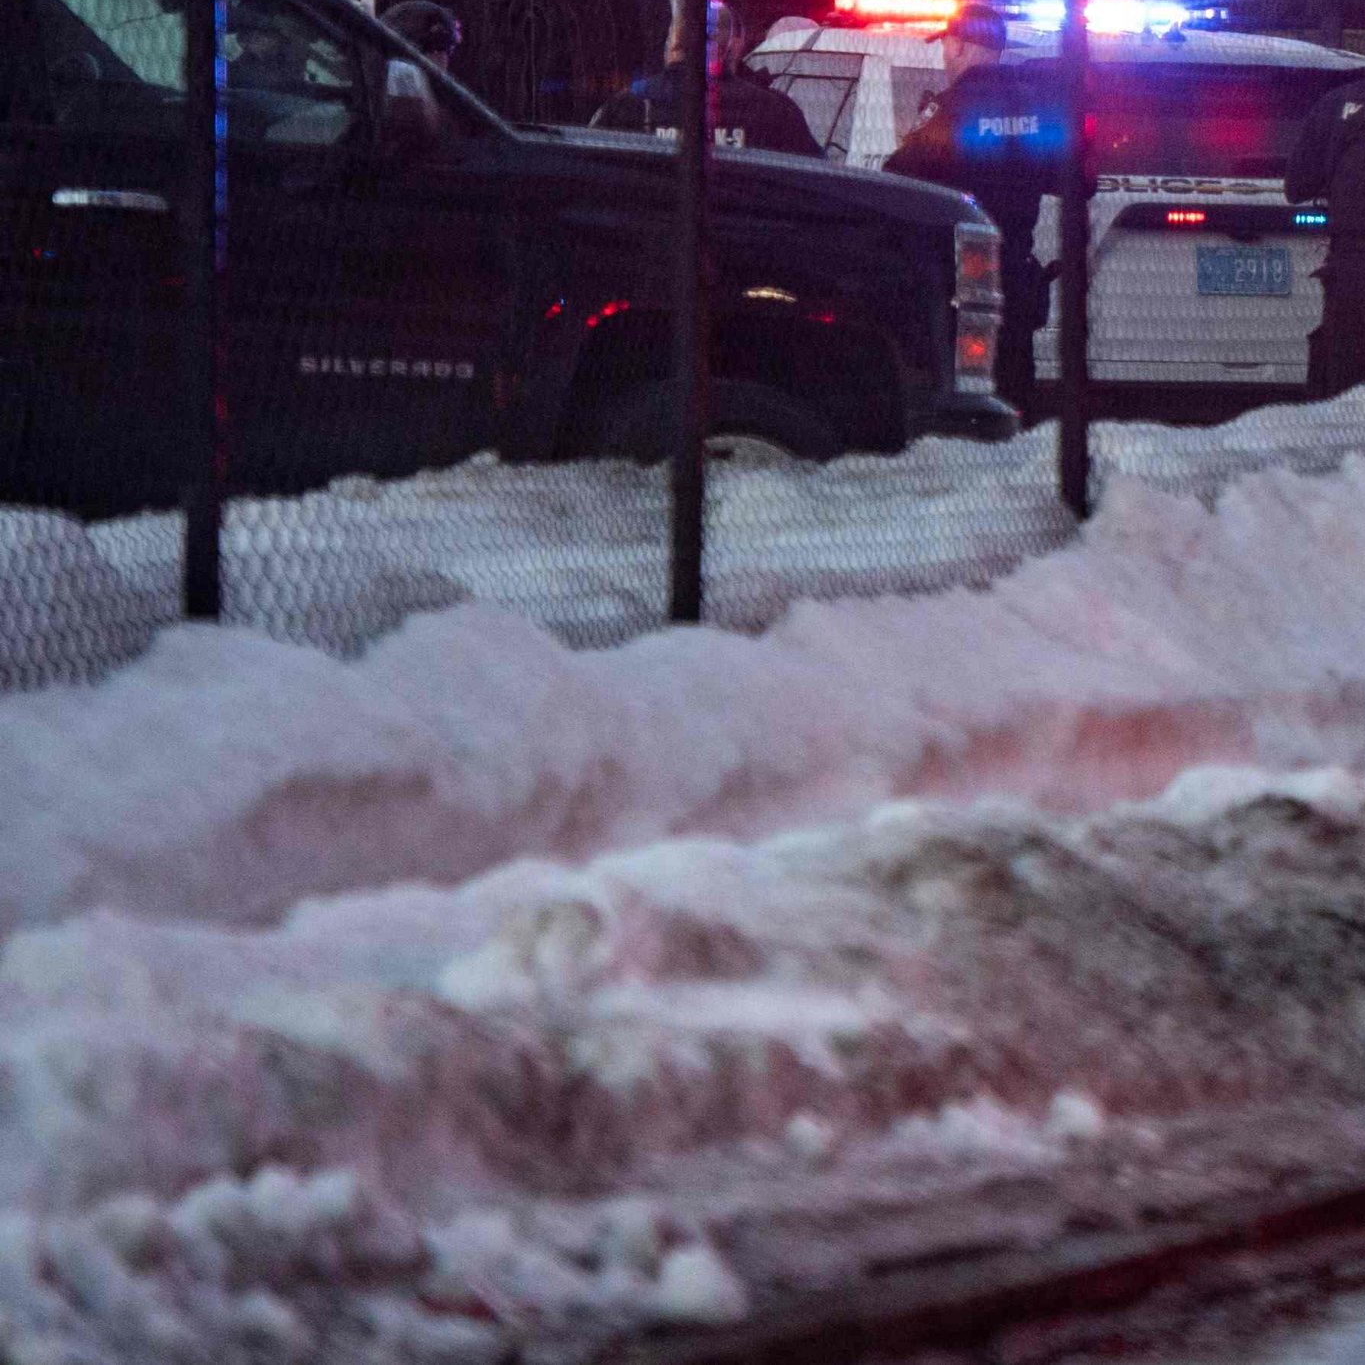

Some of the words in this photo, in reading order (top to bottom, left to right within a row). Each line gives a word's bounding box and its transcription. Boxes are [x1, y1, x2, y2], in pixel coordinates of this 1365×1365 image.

[979, 115, 1040, 136] POLICE
[1097, 176, 1224, 195] OLICE
[299, 356, 476, 380] SILVERADO
